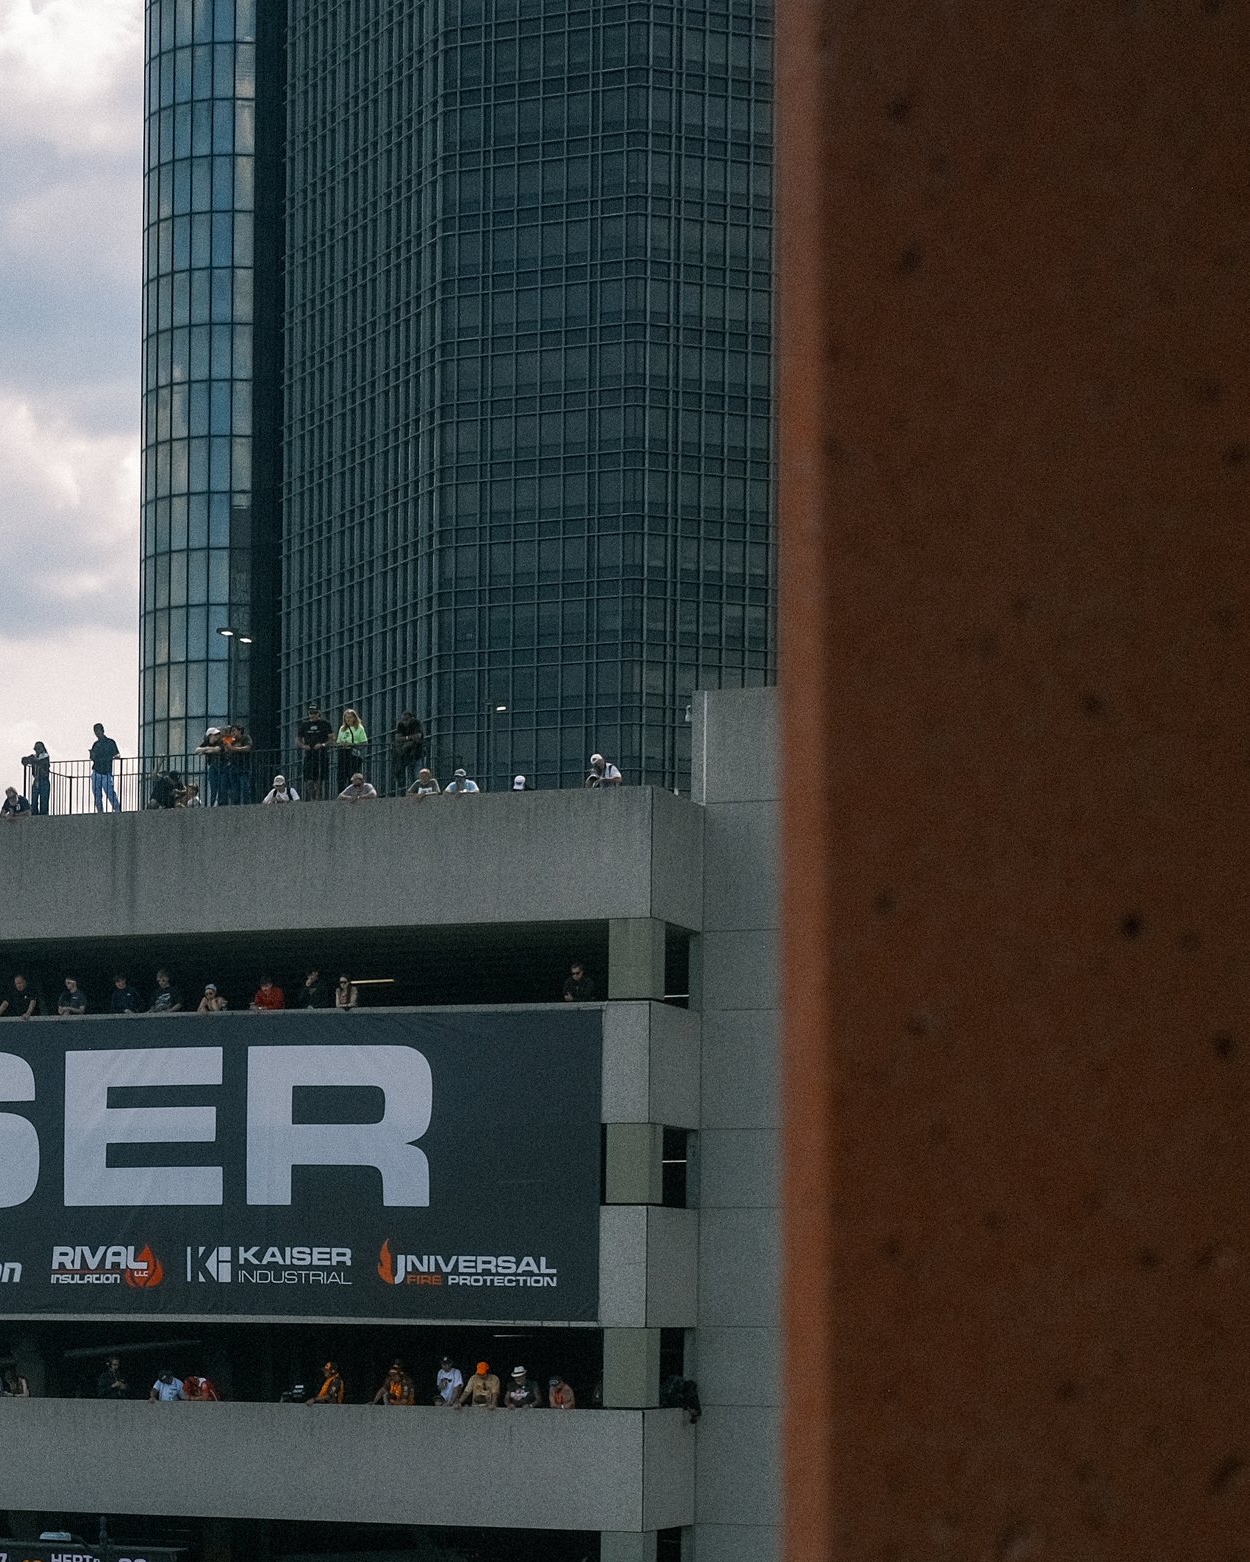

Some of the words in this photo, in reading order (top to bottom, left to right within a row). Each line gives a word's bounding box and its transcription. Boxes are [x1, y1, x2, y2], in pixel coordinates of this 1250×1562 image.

[52, 1245, 148, 1270] RIVAL
[238, 1246, 352, 1266] KAISER
[50, 1273, 120, 1284] INSULATION
[238, 1270, 352, 1285] INDUSTRIAL
[406, 1275, 442, 1285] FIRE
[447, 1275, 557, 1287] PROTECTION
